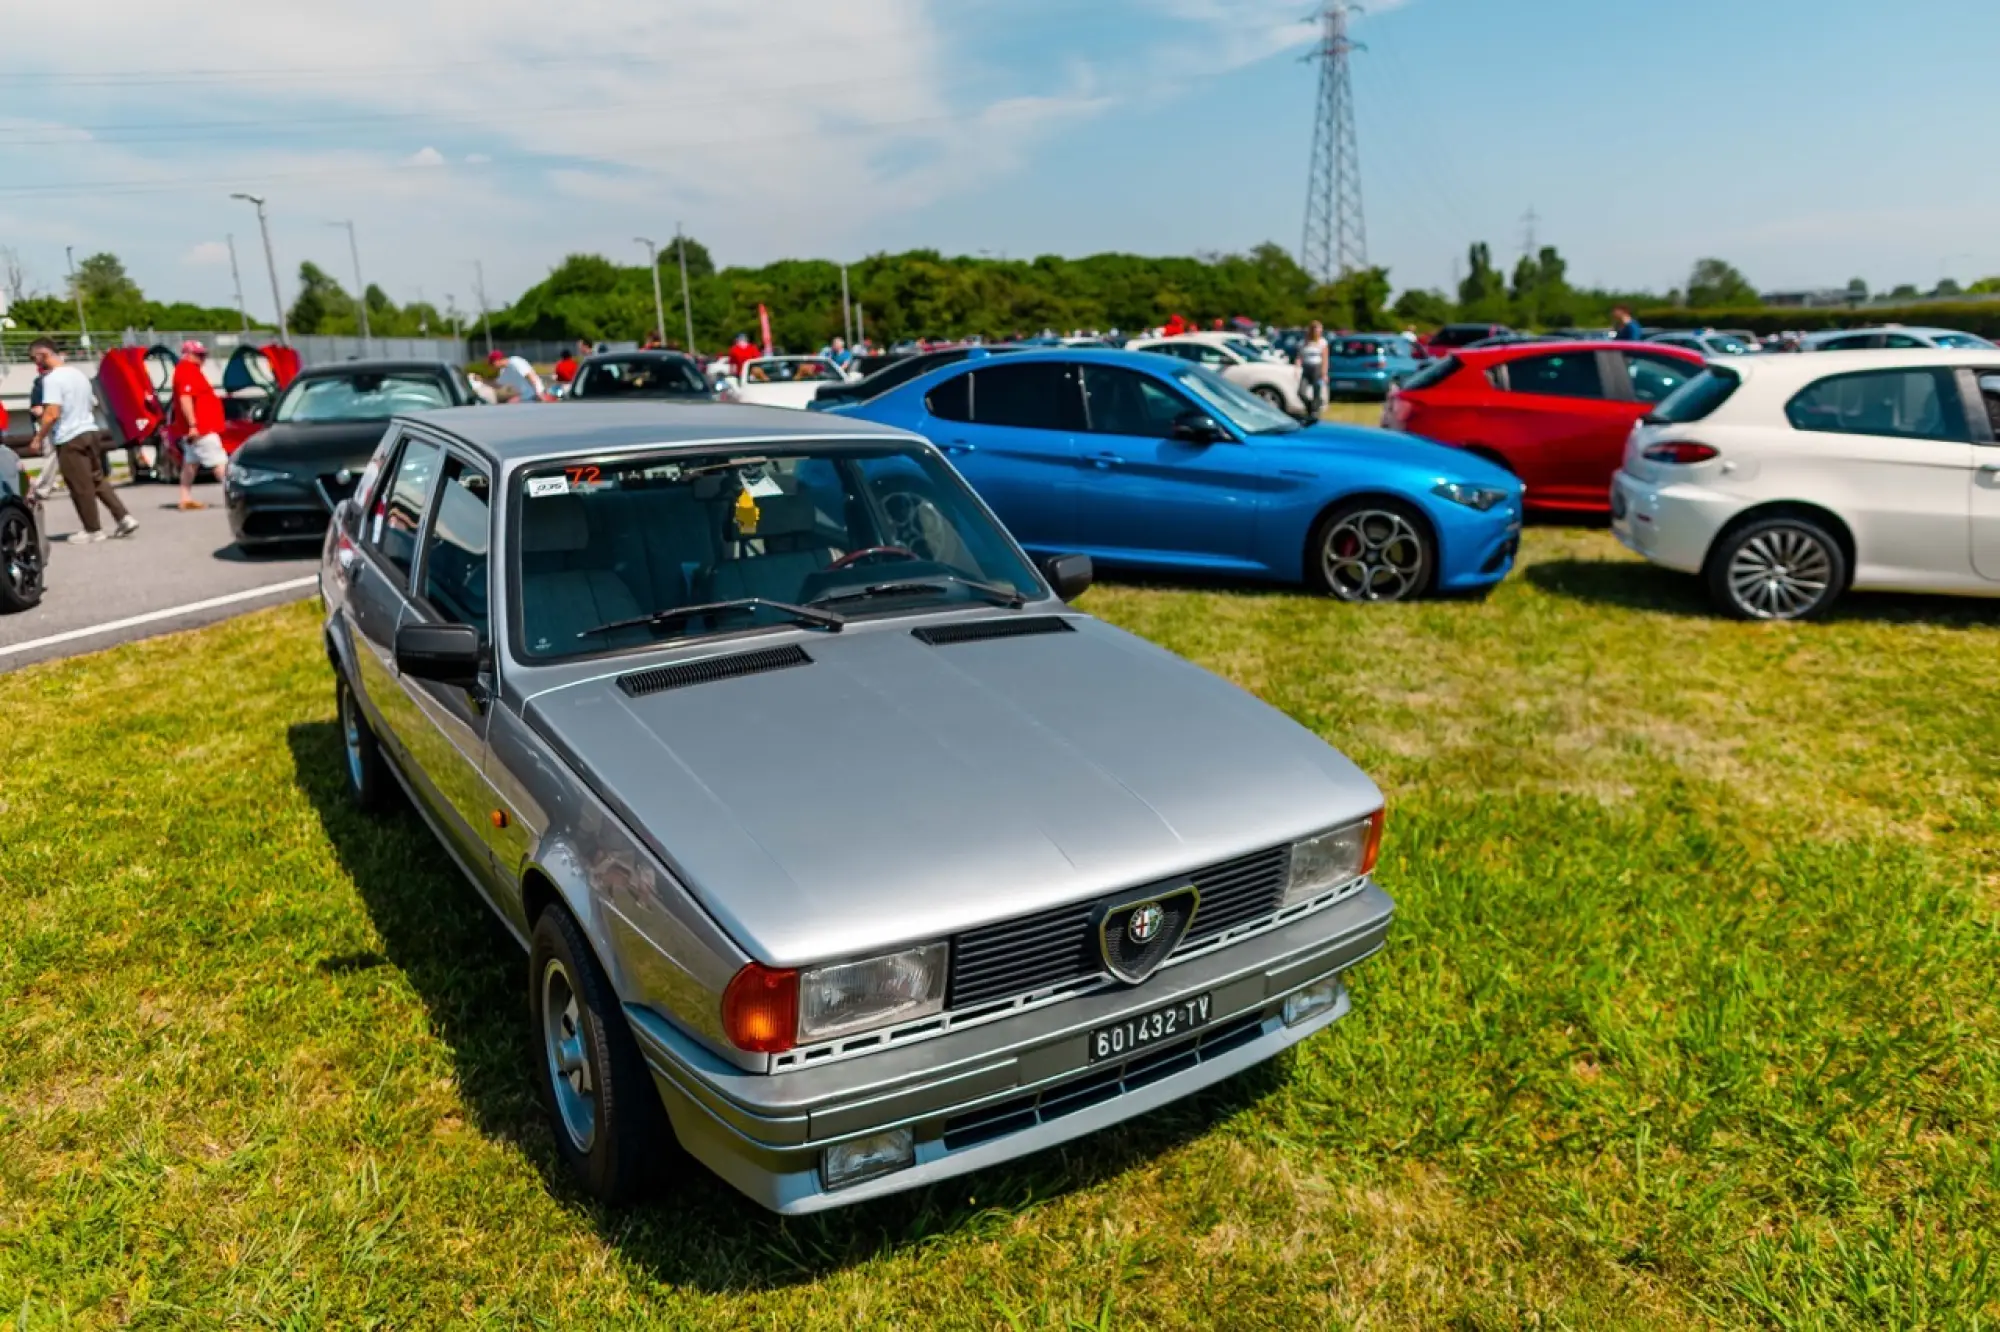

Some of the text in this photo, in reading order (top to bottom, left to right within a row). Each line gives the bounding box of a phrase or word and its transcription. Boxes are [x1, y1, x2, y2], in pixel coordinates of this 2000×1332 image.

[565, 466, 601, 488] 72
[1097, 996, 1209, 1057] 601432 TV
